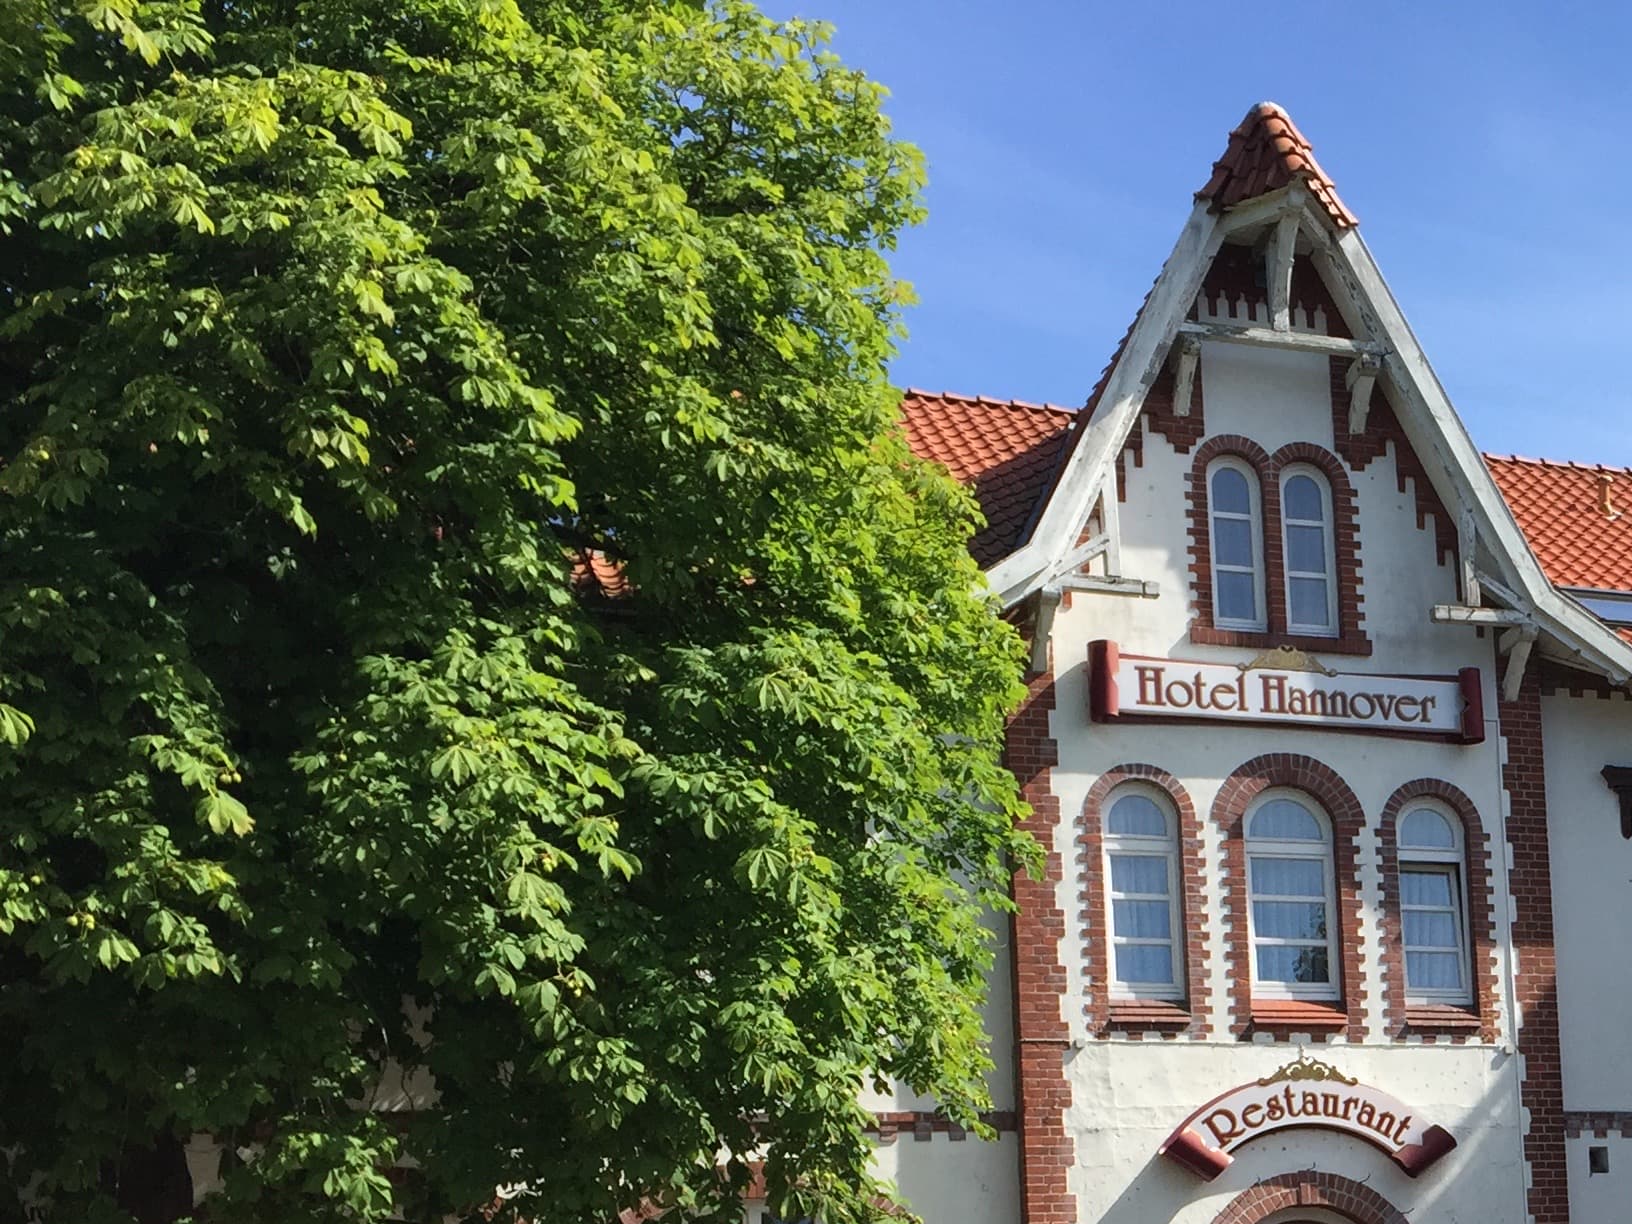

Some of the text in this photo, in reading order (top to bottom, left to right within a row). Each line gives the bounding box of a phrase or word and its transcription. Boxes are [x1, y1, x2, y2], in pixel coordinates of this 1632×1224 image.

[1134, 665, 1437, 724] Hotel Hannover
[1201, 1084, 1412, 1148] Restaurant
